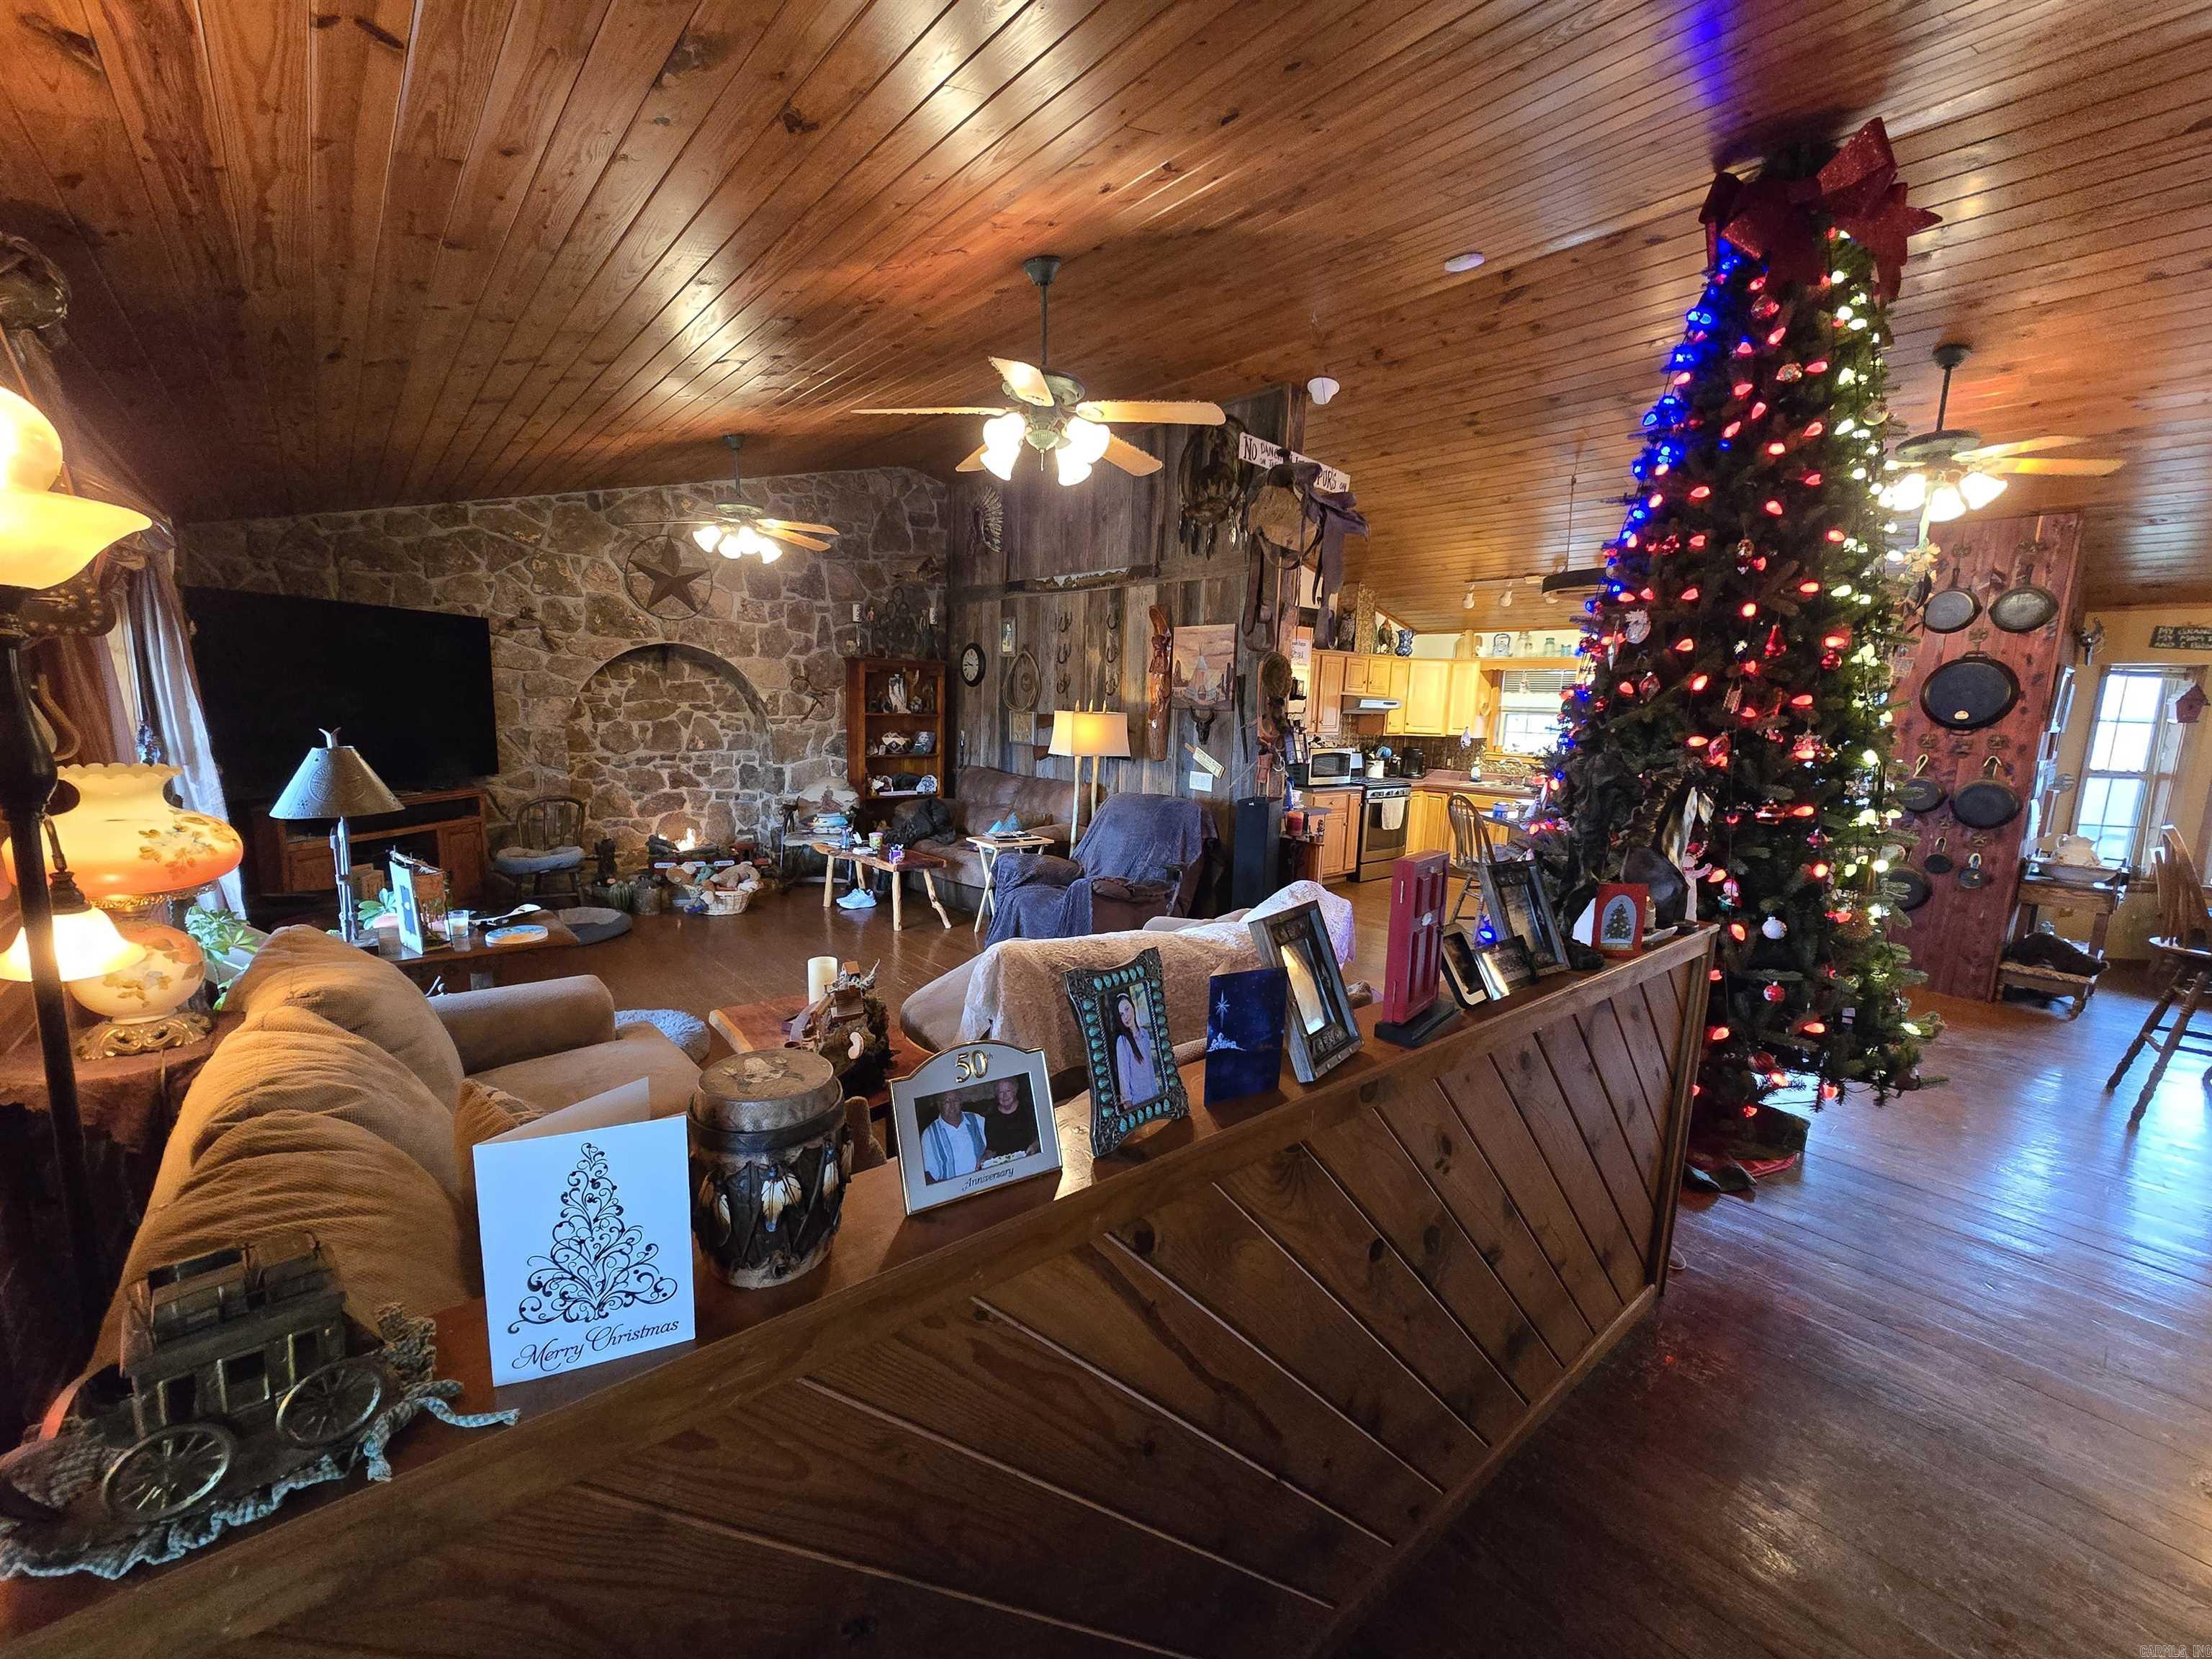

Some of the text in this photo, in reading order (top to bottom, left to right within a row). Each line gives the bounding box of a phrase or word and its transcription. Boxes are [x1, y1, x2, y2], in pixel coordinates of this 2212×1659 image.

[1317, 469, 1337, 490] PURS
[962, 1166, 1015, 1192] Anniversary
[511, 1320, 680, 1372] Merry Christmas
